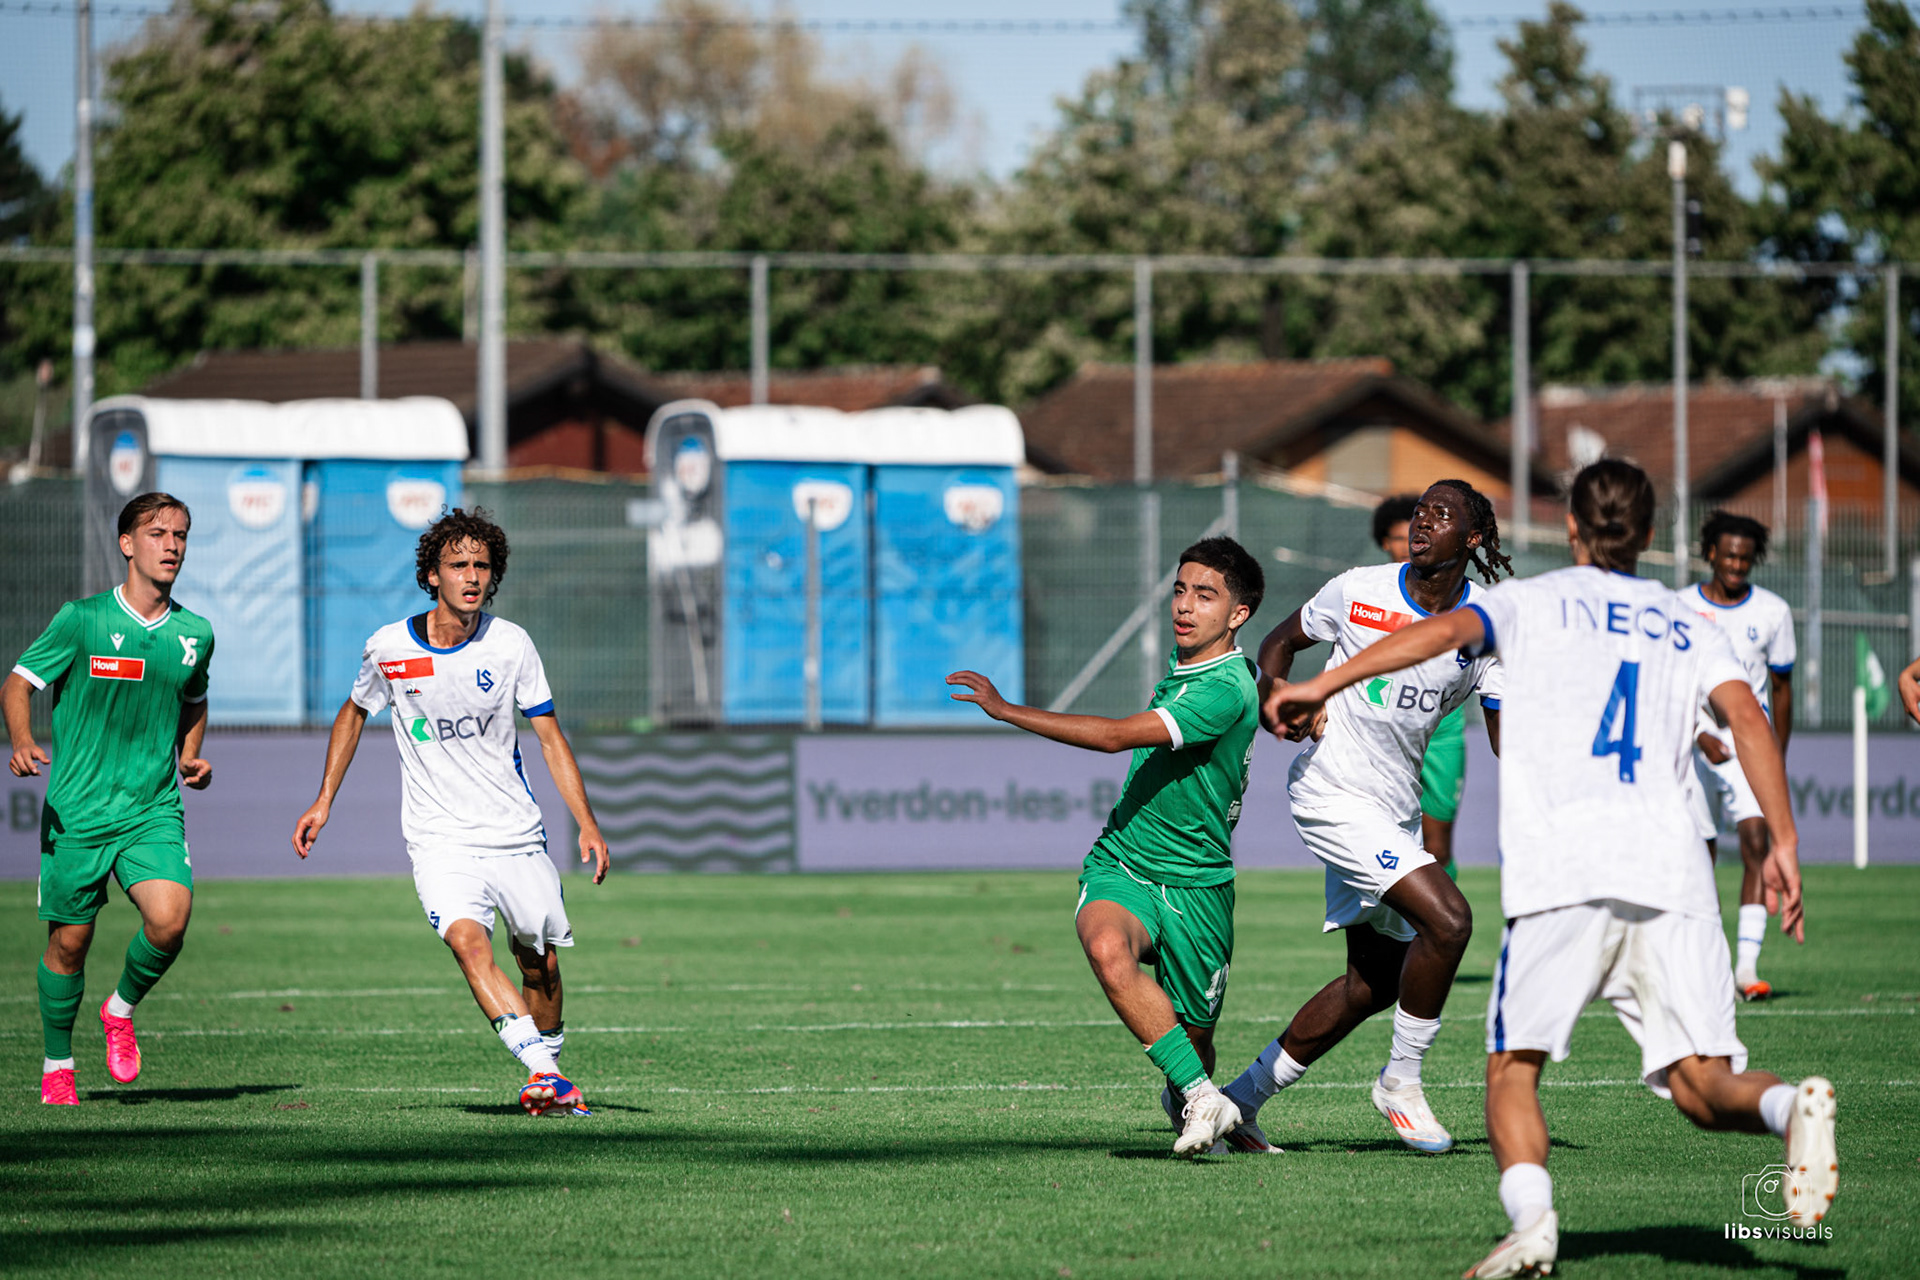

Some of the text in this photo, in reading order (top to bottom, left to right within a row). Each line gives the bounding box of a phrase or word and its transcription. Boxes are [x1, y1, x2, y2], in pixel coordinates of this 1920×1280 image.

[1353, 605, 1383, 622] Hoval
[1562, 598, 1691, 651] INEOS
[93, 659, 119, 671] Hoval
[381, 662, 406, 674] Hoval
[436, 713, 495, 742] BCV
[1592, 660, 1642, 784] 4
